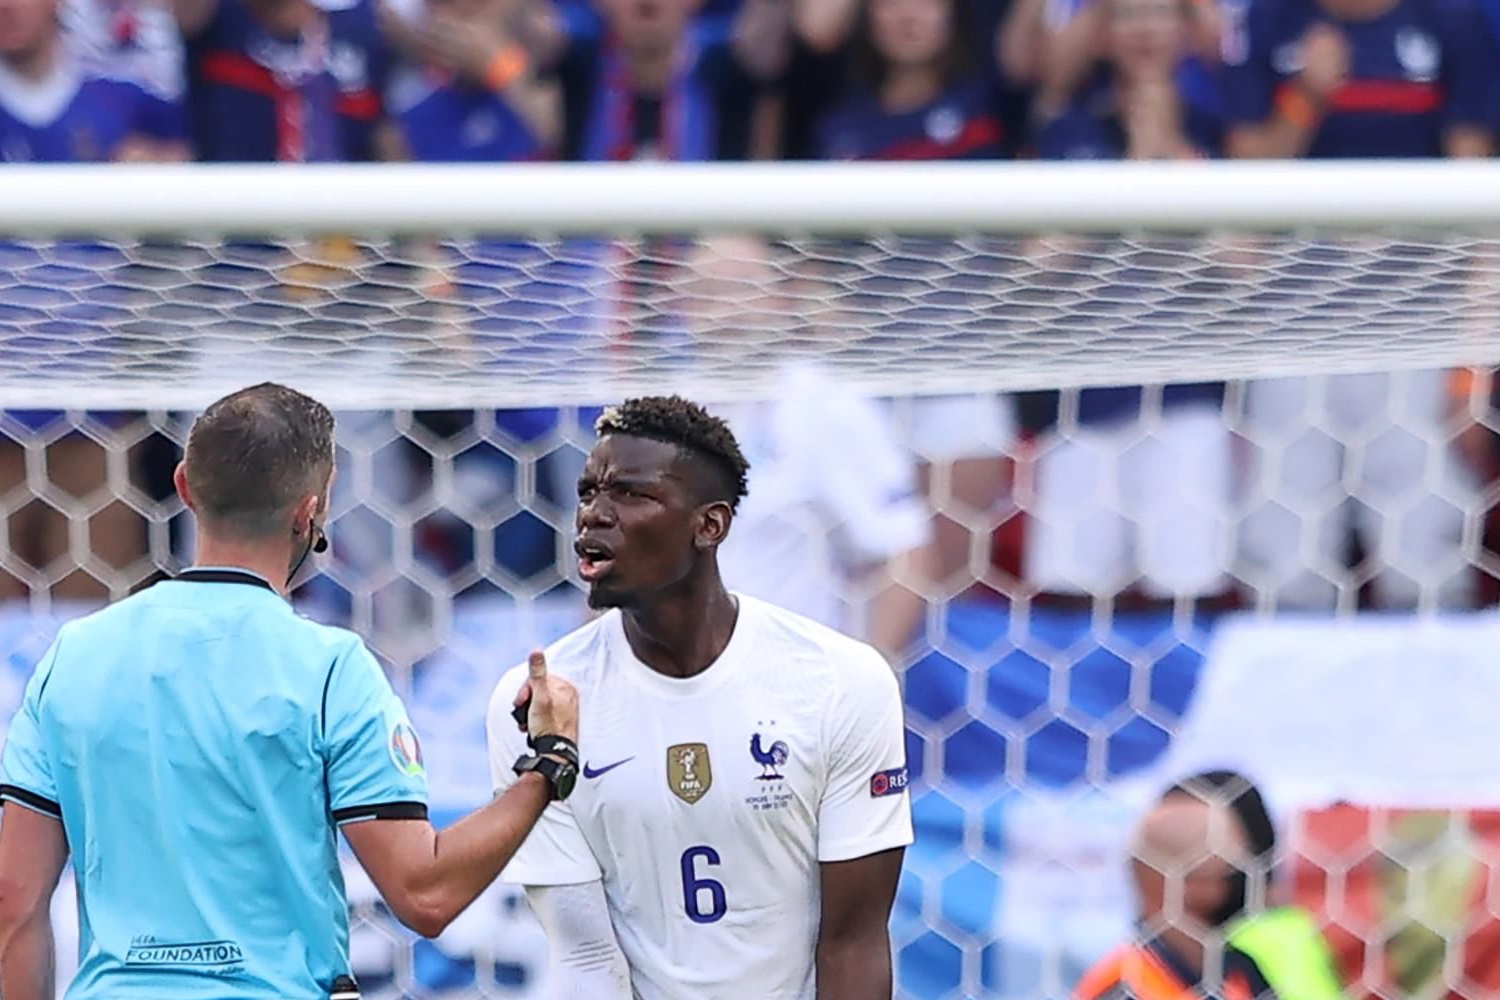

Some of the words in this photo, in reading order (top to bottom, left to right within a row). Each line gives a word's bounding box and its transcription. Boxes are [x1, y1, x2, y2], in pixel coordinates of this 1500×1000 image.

[680, 781, 701, 790] FIFA
[681, 845, 728, 924] 6
[125, 944, 243, 962] FOUNDATION
